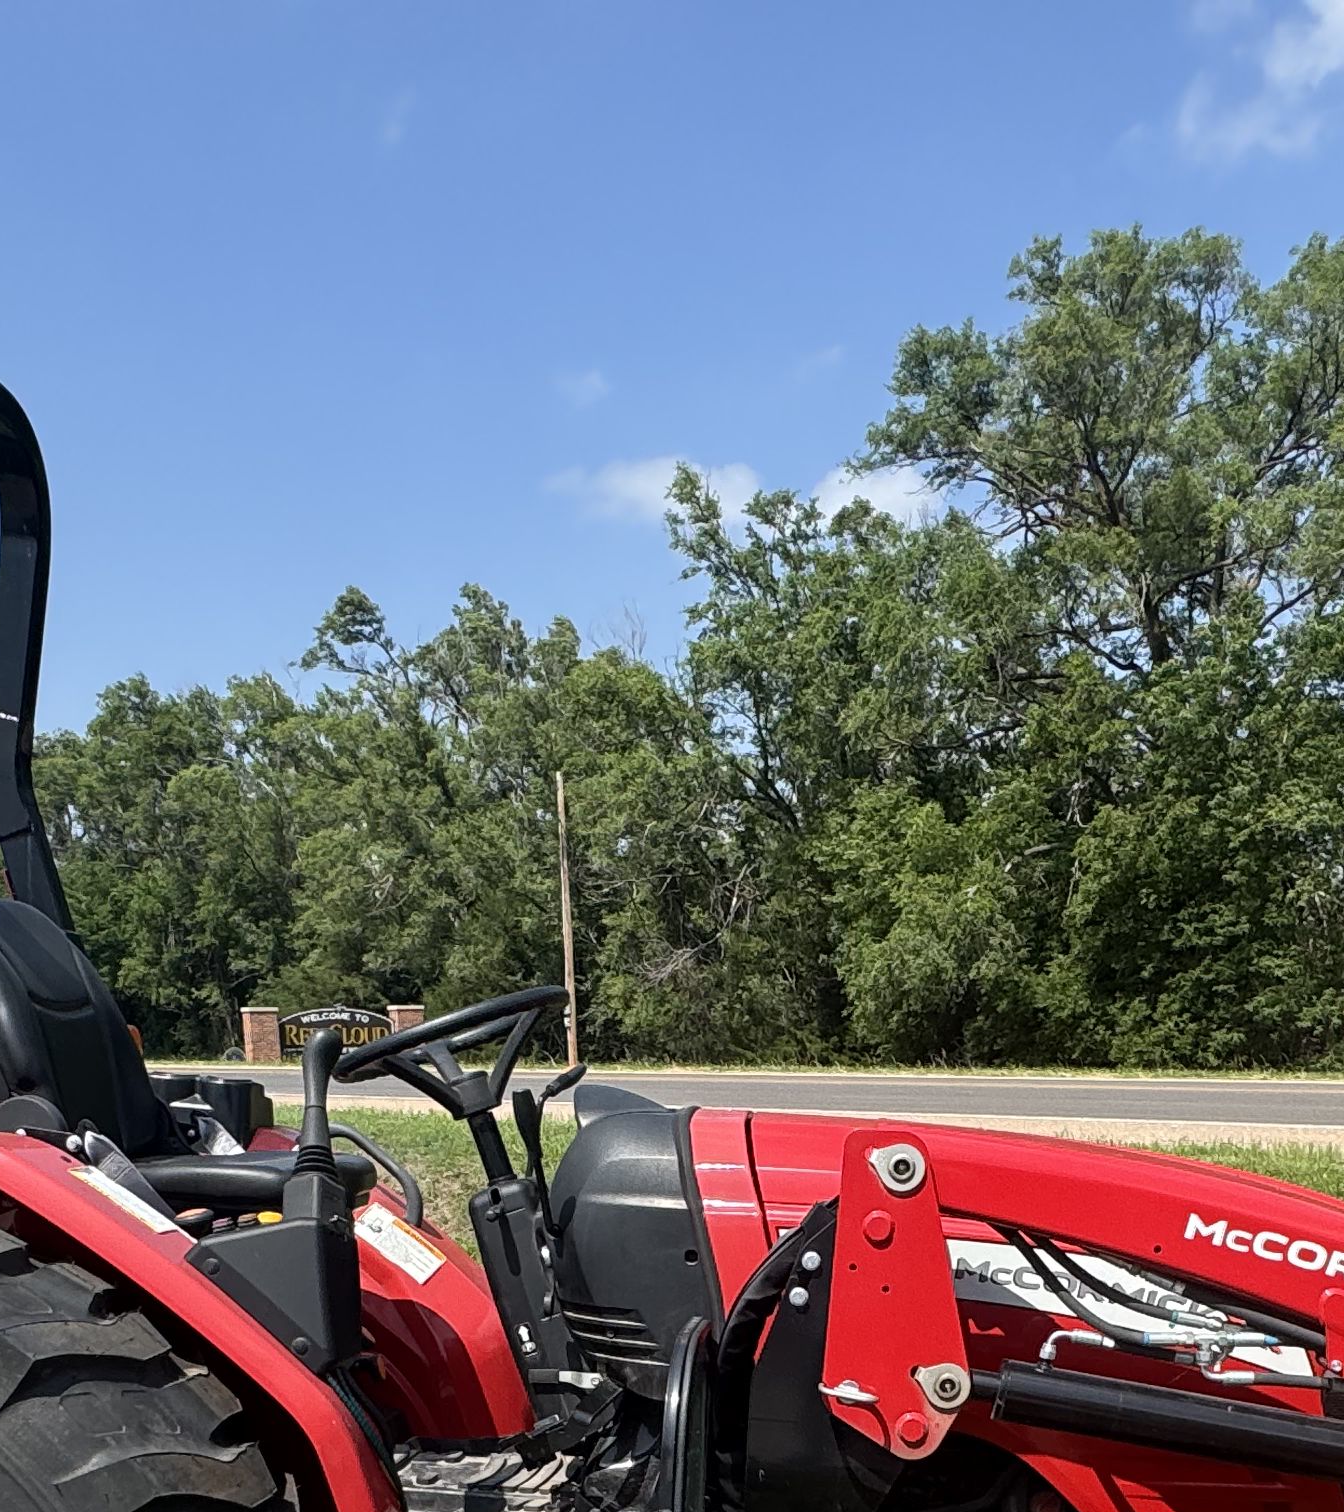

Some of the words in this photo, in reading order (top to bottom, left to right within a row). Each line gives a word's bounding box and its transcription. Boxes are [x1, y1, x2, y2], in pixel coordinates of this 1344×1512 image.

[300, 1011, 351, 1024] WELCOME
[355, 1013, 370, 1024] TO
[284, 1024, 315, 1046] RE
